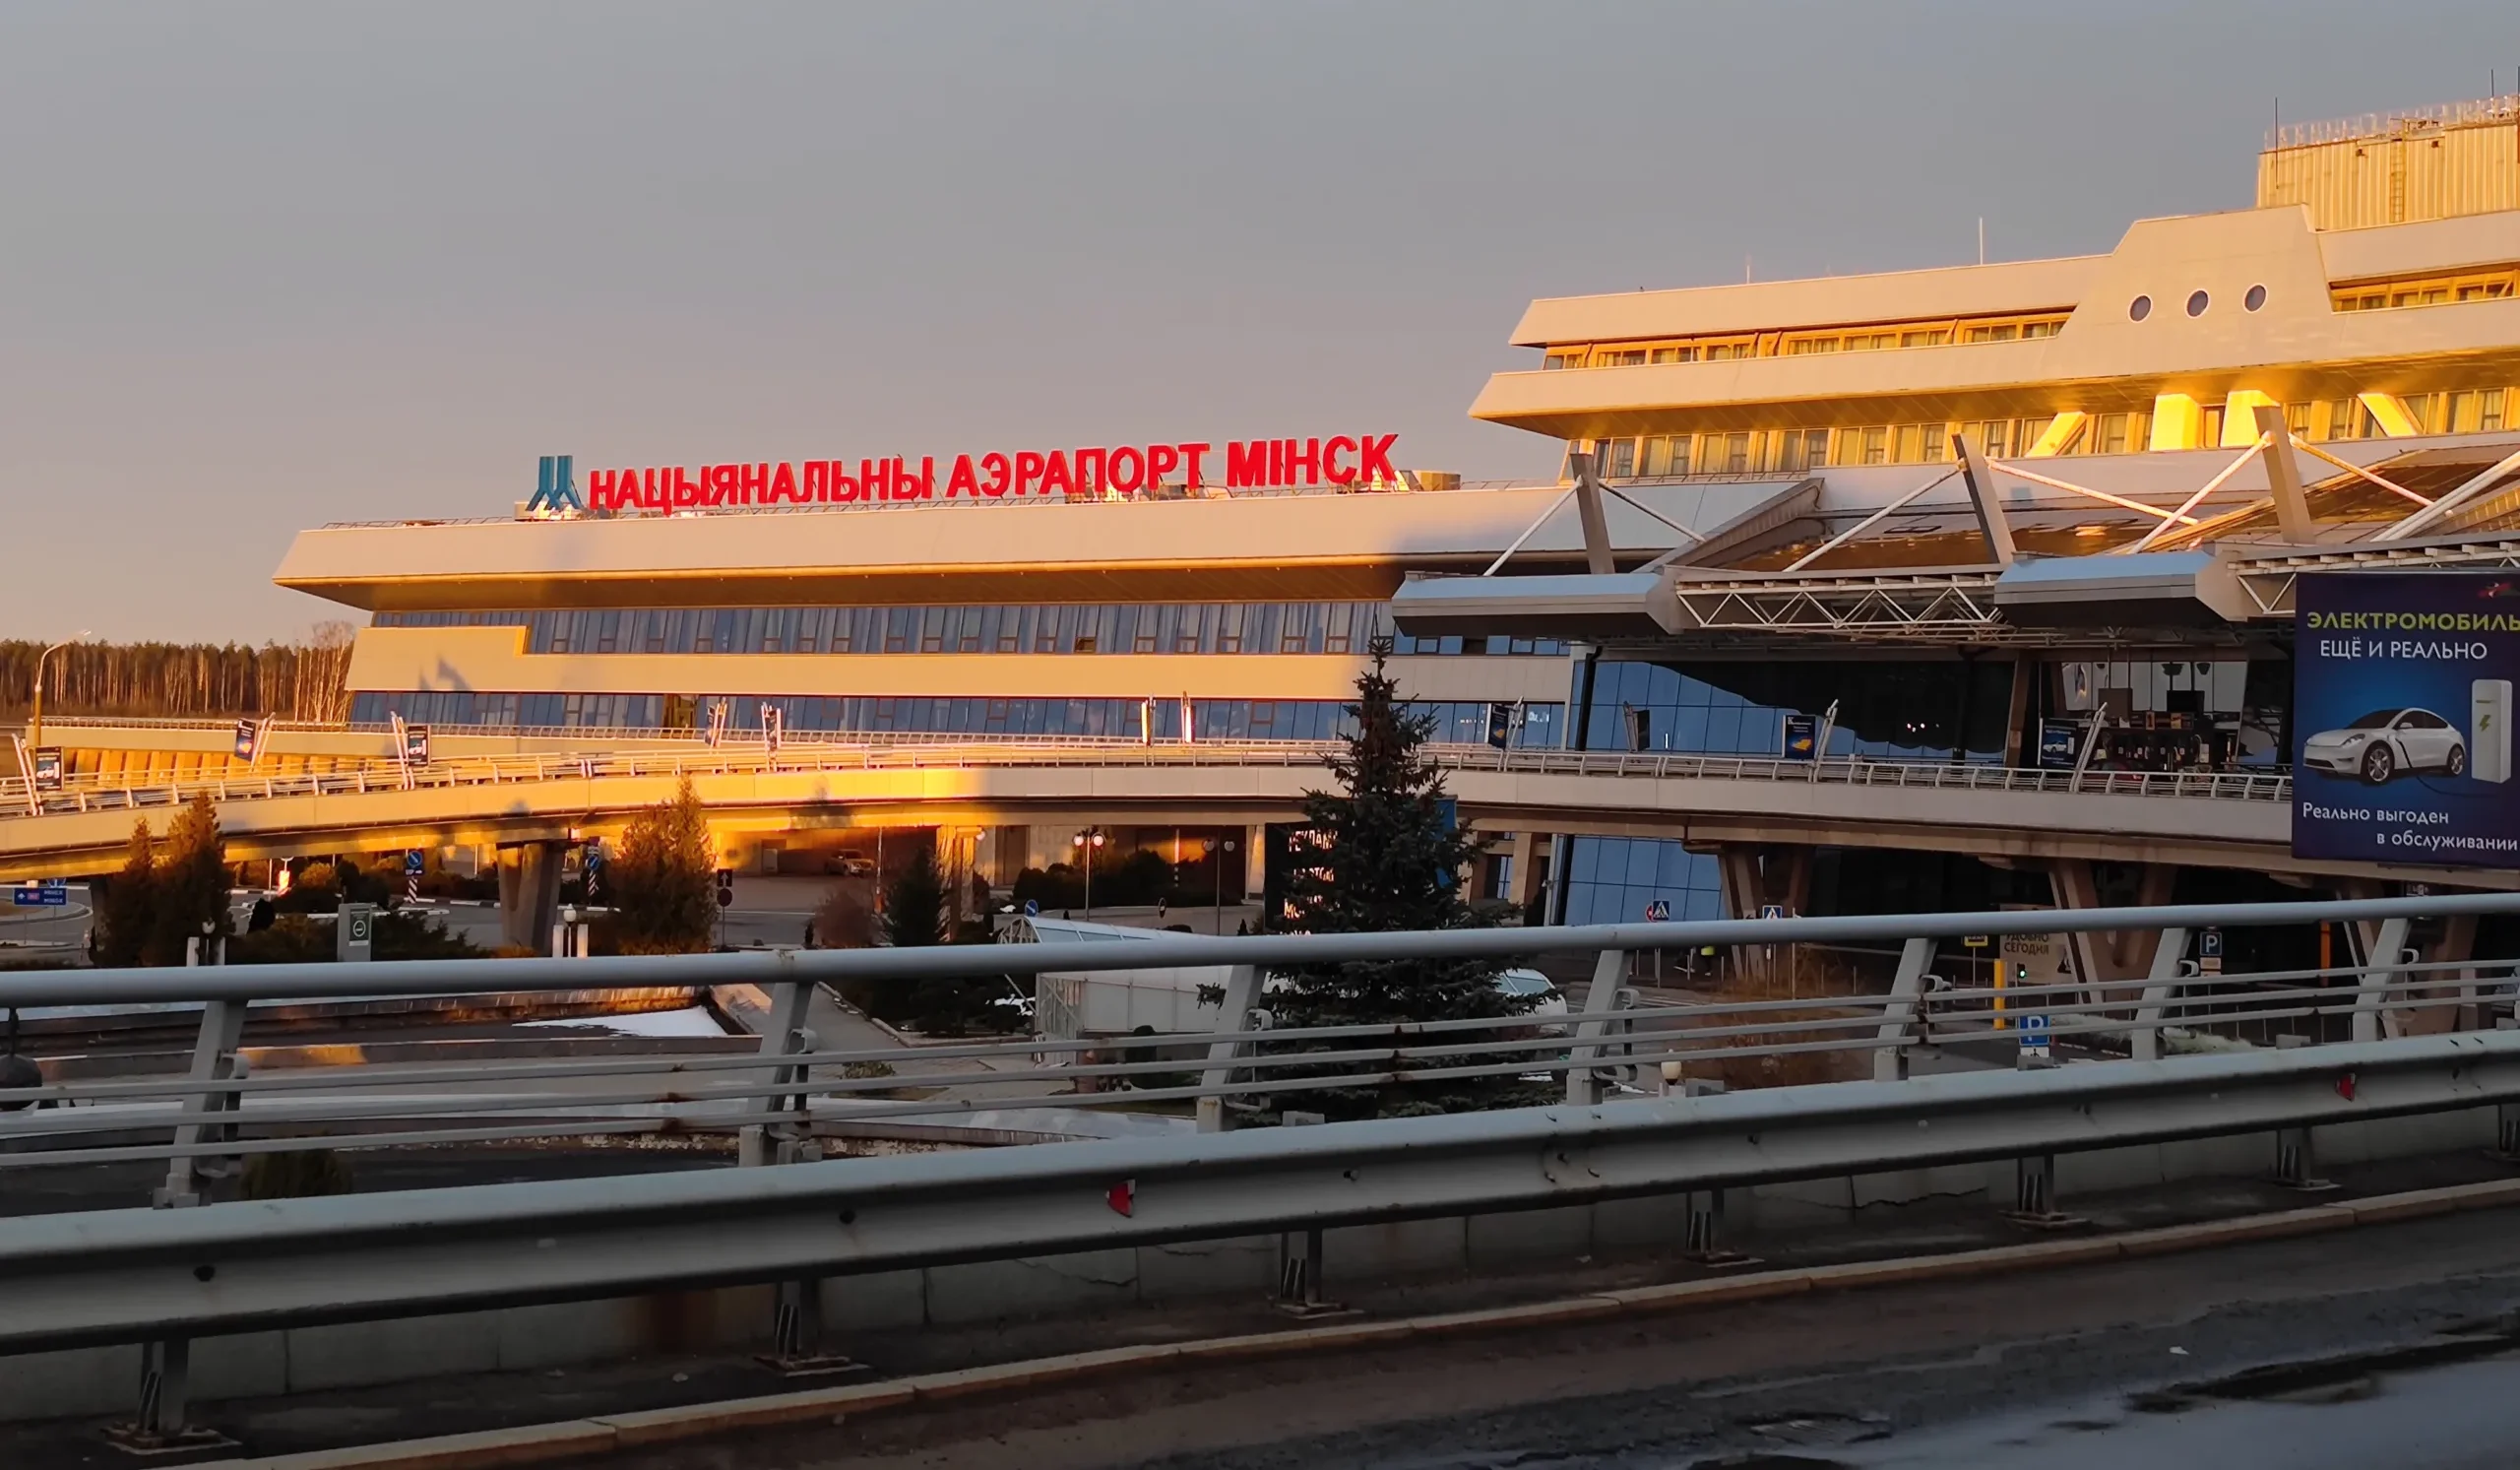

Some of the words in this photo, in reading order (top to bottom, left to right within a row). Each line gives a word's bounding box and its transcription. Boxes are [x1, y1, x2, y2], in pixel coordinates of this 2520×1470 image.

[590, 455, 934, 516] НАЦЫЯНАЛЬНЫ
[945, 442, 1211, 498] АЭРАПОРТ
[1226, 433, 1399, 488] МІНСК
[2320, 636, 2362, 661] ЕЩЁ
[2368, 640, 2383, 659] И
[2390, 640, 2488, 661] РЕАЛЬНО
[2302, 801, 2370, 821] Реально
[2376, 808, 2449, 825] выгоден
[2376, 832, 2385, 846] в
[2391, 830, 2519, 852] обслуживании
[2003, 941, 2049, 956] СЕГОДНЯ
